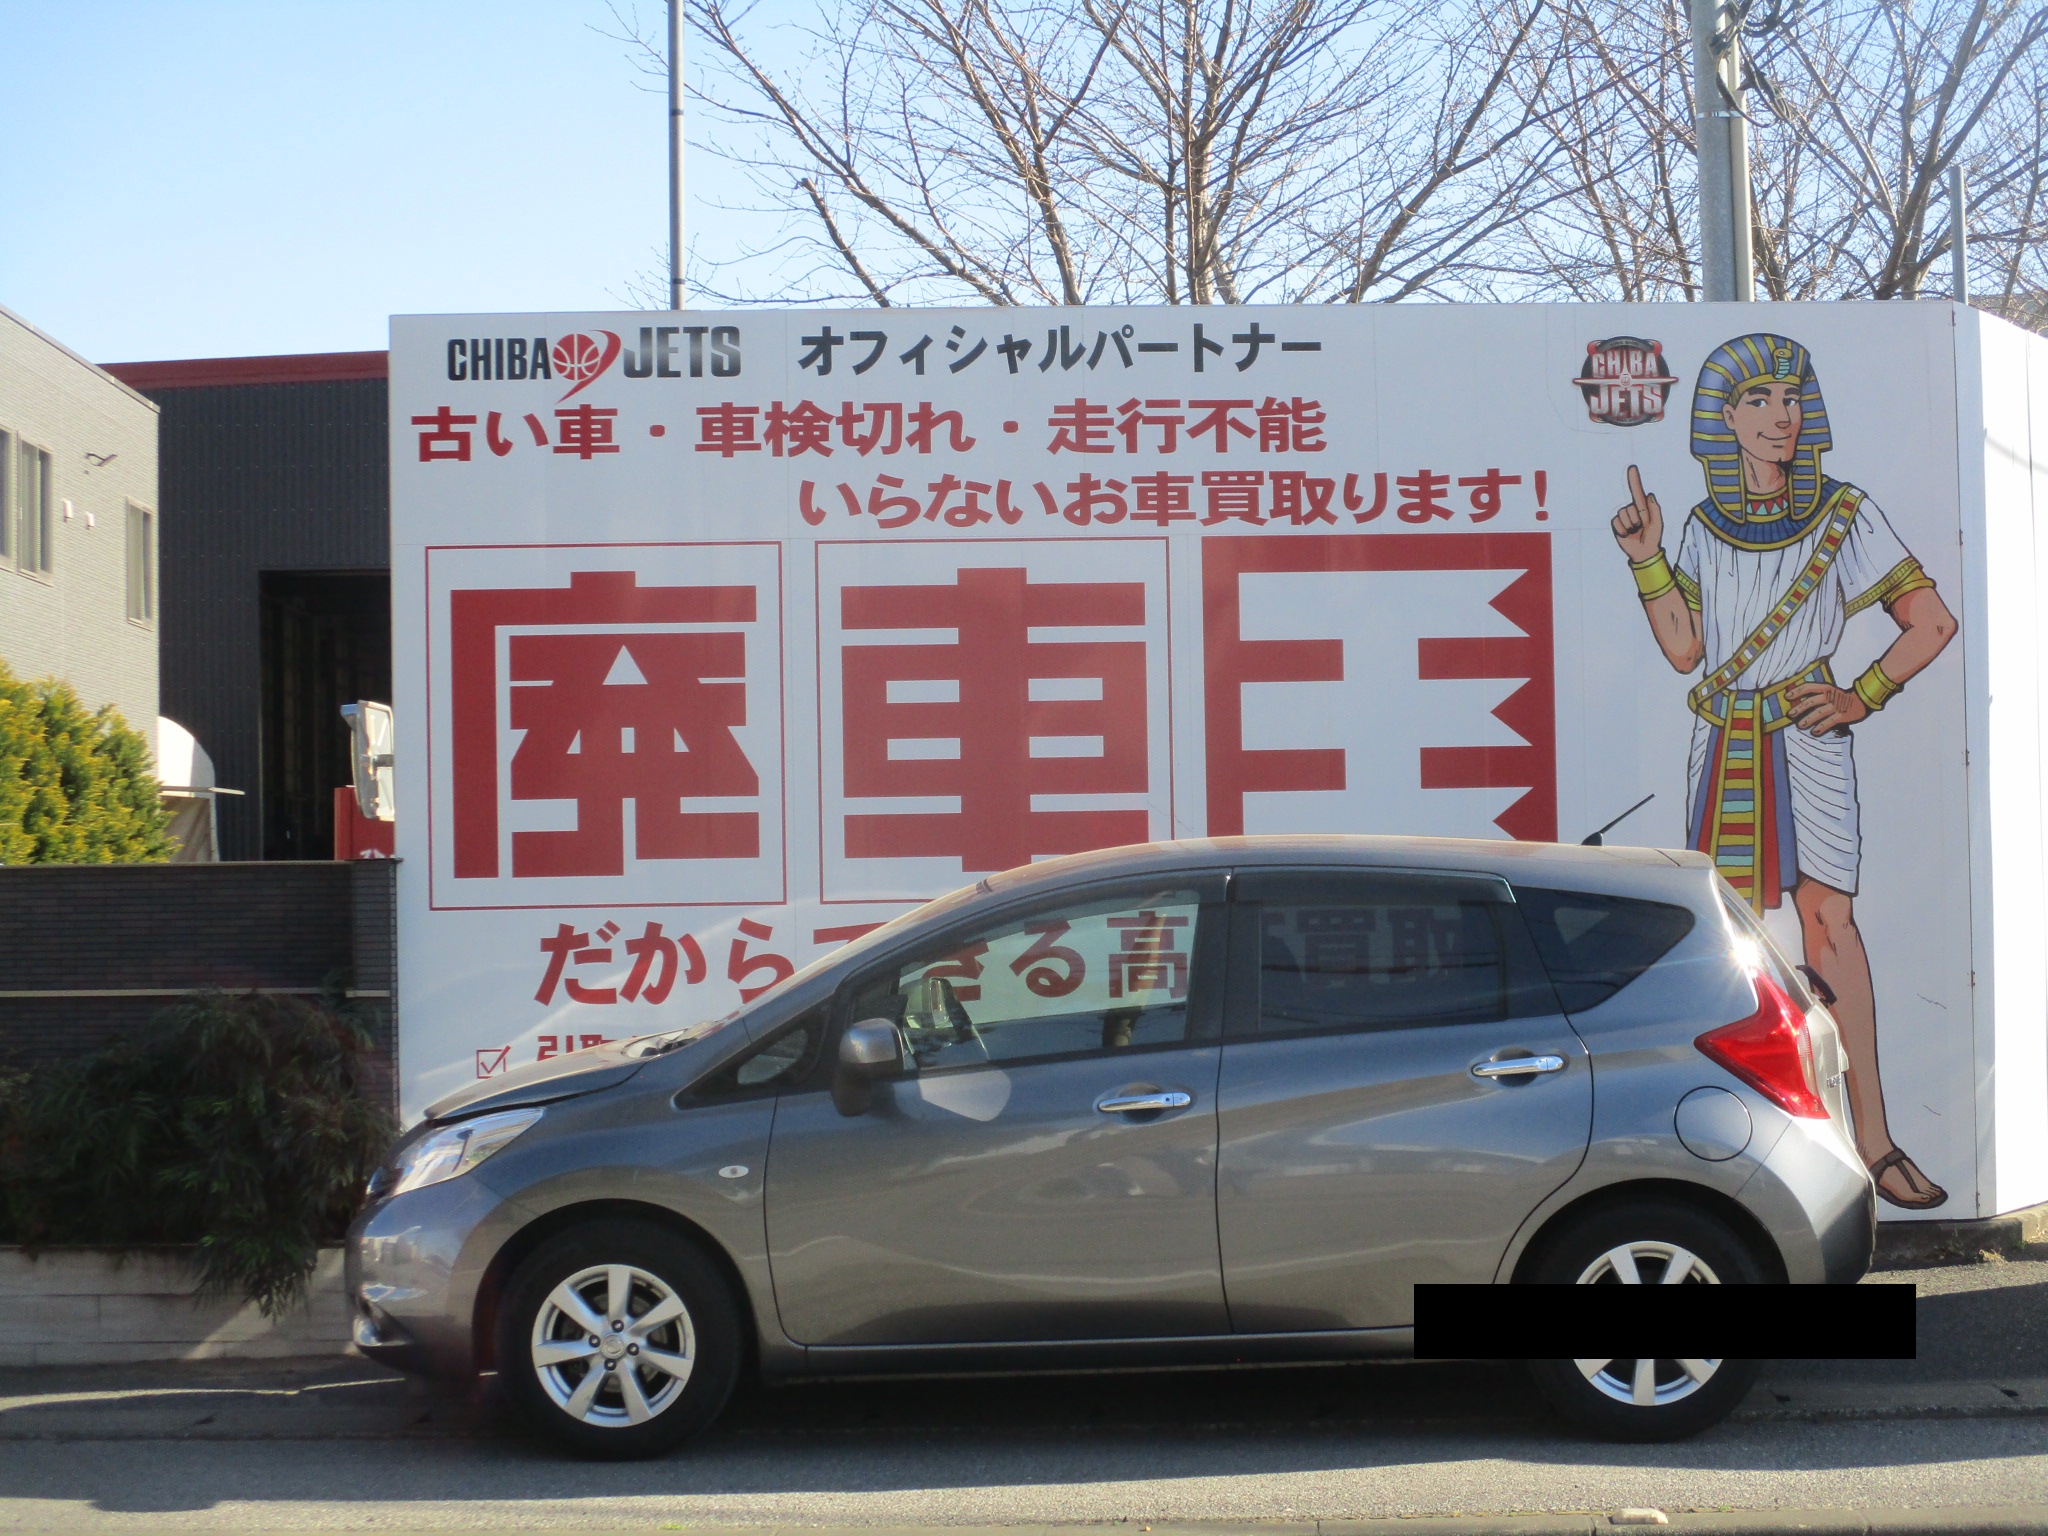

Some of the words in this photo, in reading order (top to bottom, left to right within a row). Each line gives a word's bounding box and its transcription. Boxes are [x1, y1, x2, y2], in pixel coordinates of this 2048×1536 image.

[447, 338, 552, 381] CHIBA
[623, 326, 741, 378] JETS
[798, 323, 1322, 376] オフィシャルパートナー
[1593, 350, 1658, 377] CHIBA
[1590, 384, 1662, 417] JETS
[411, 397, 1328, 462] 古い車・車検切れ・走行不能
[800, 469, 1549, 527] いらないお車買取ります!
